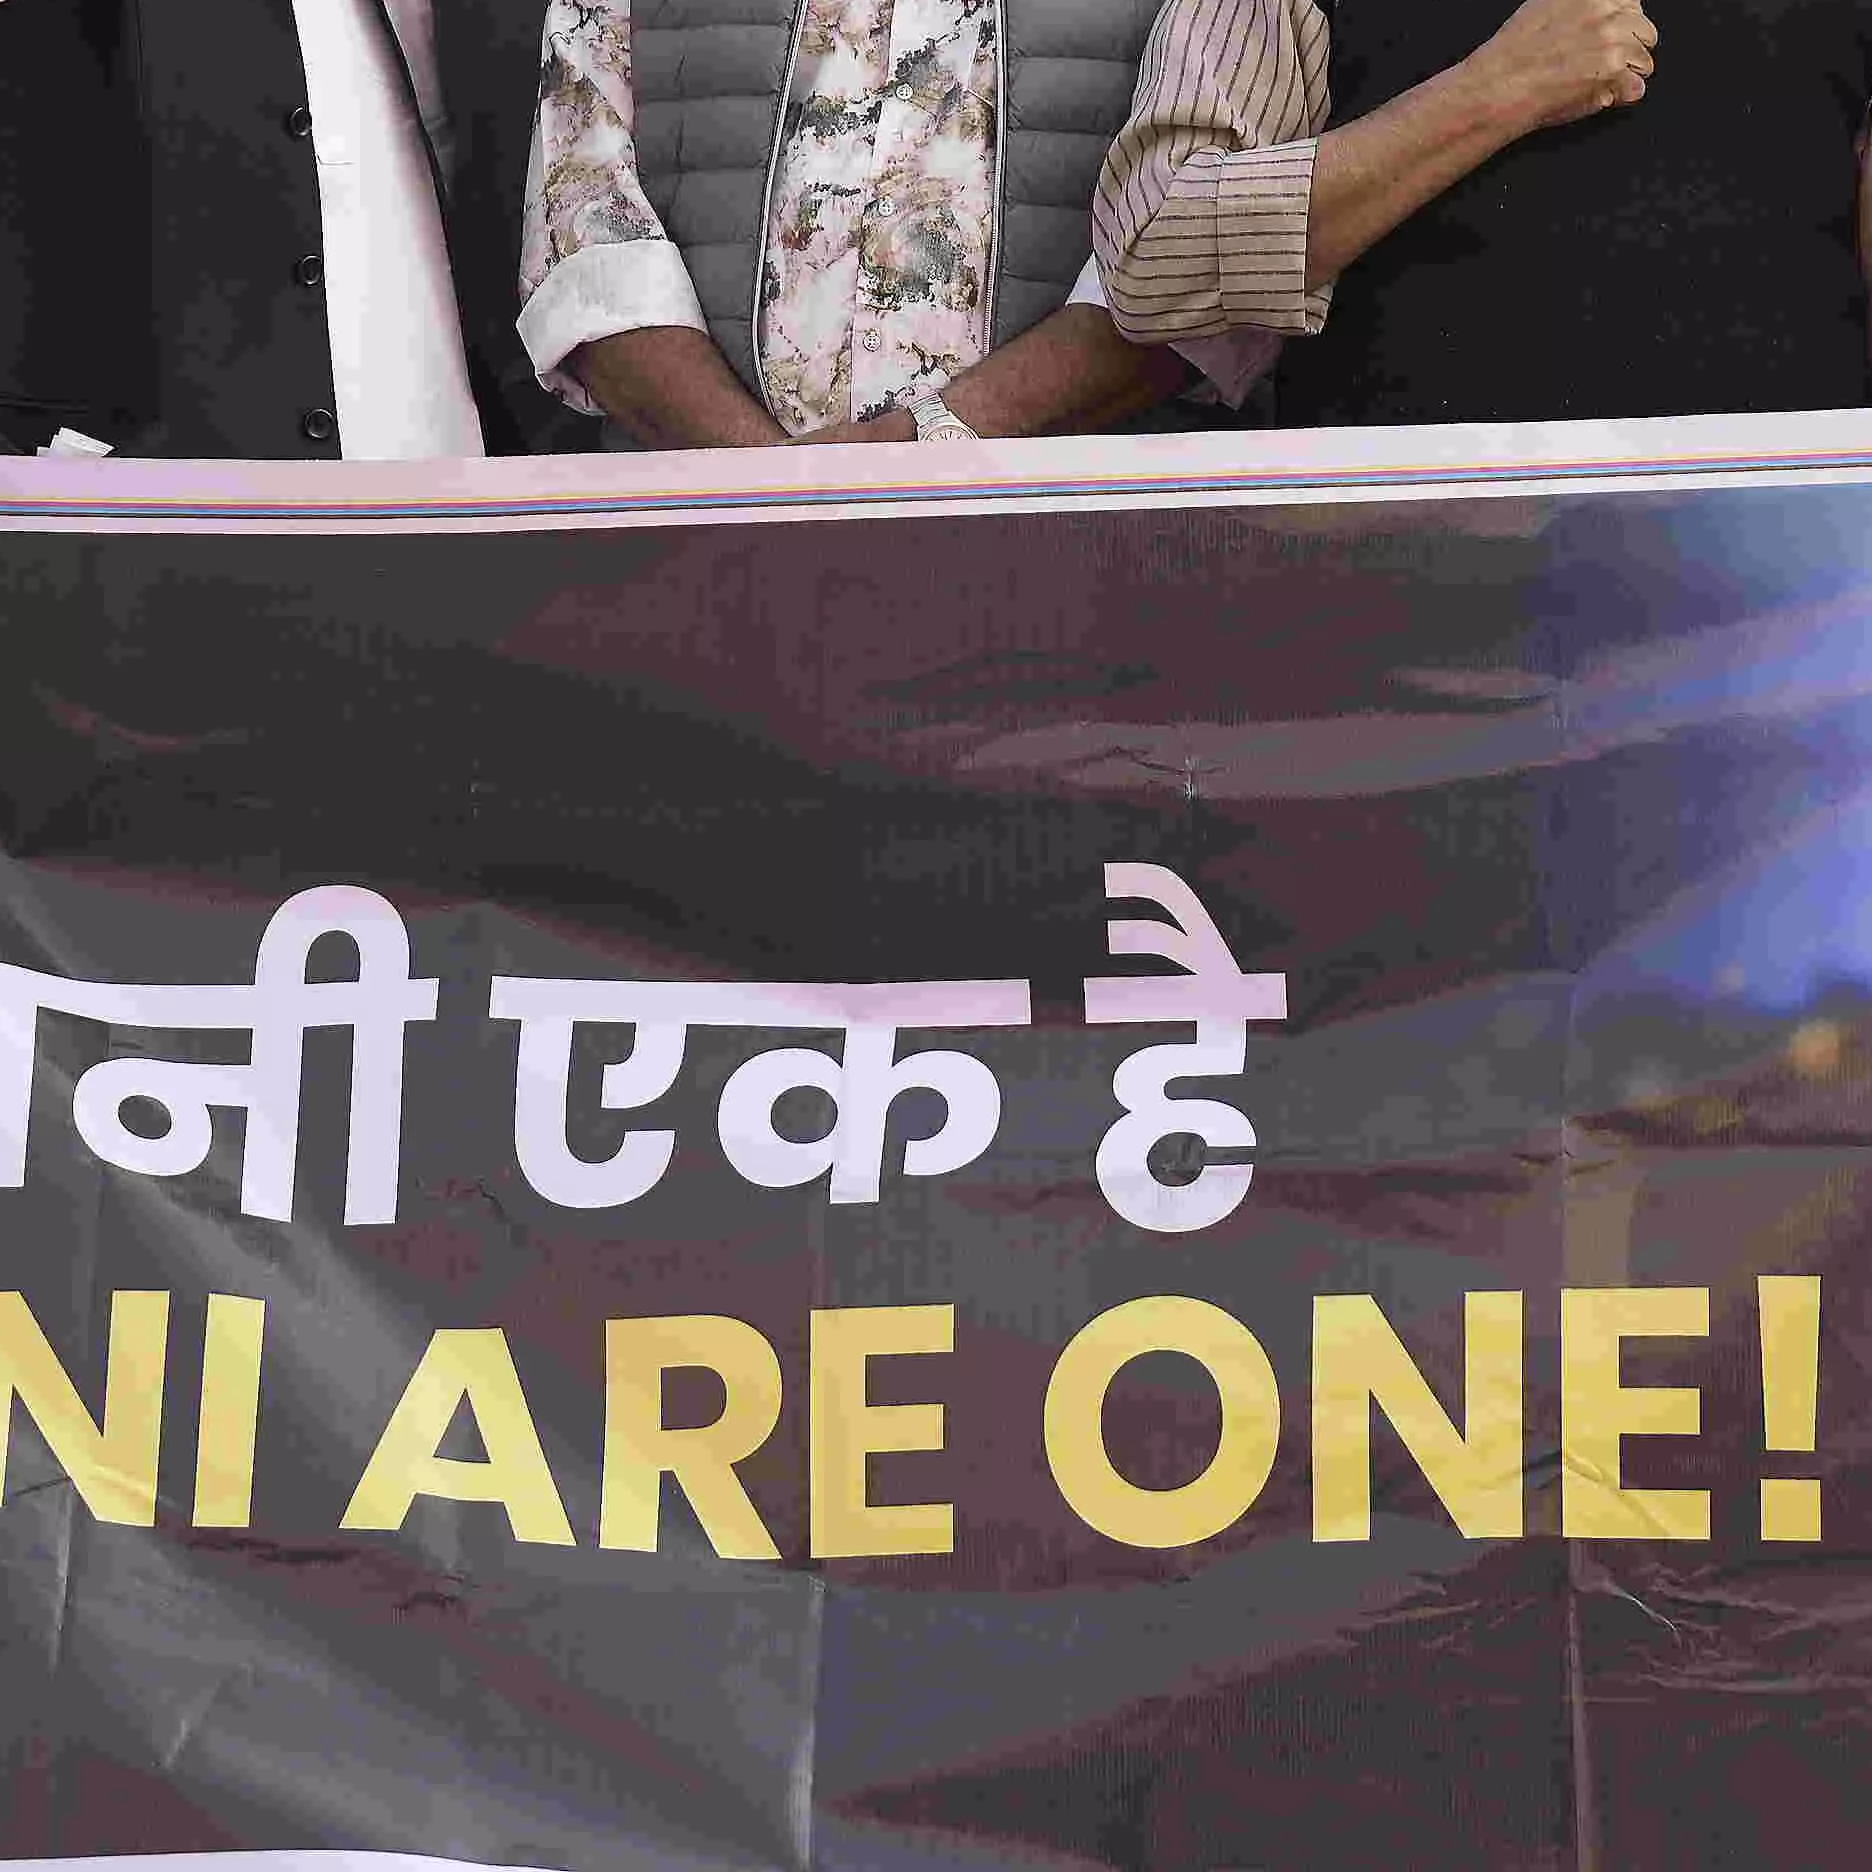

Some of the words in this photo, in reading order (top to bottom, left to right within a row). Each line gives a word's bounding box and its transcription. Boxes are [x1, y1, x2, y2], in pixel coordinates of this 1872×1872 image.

[490, 974, 1032, 1211] एक
[1084, 861, 1287, 1233] है
[337, 1302, 955, 1560] ARE
[1042, 1273, 1822, 1543] ONE!
